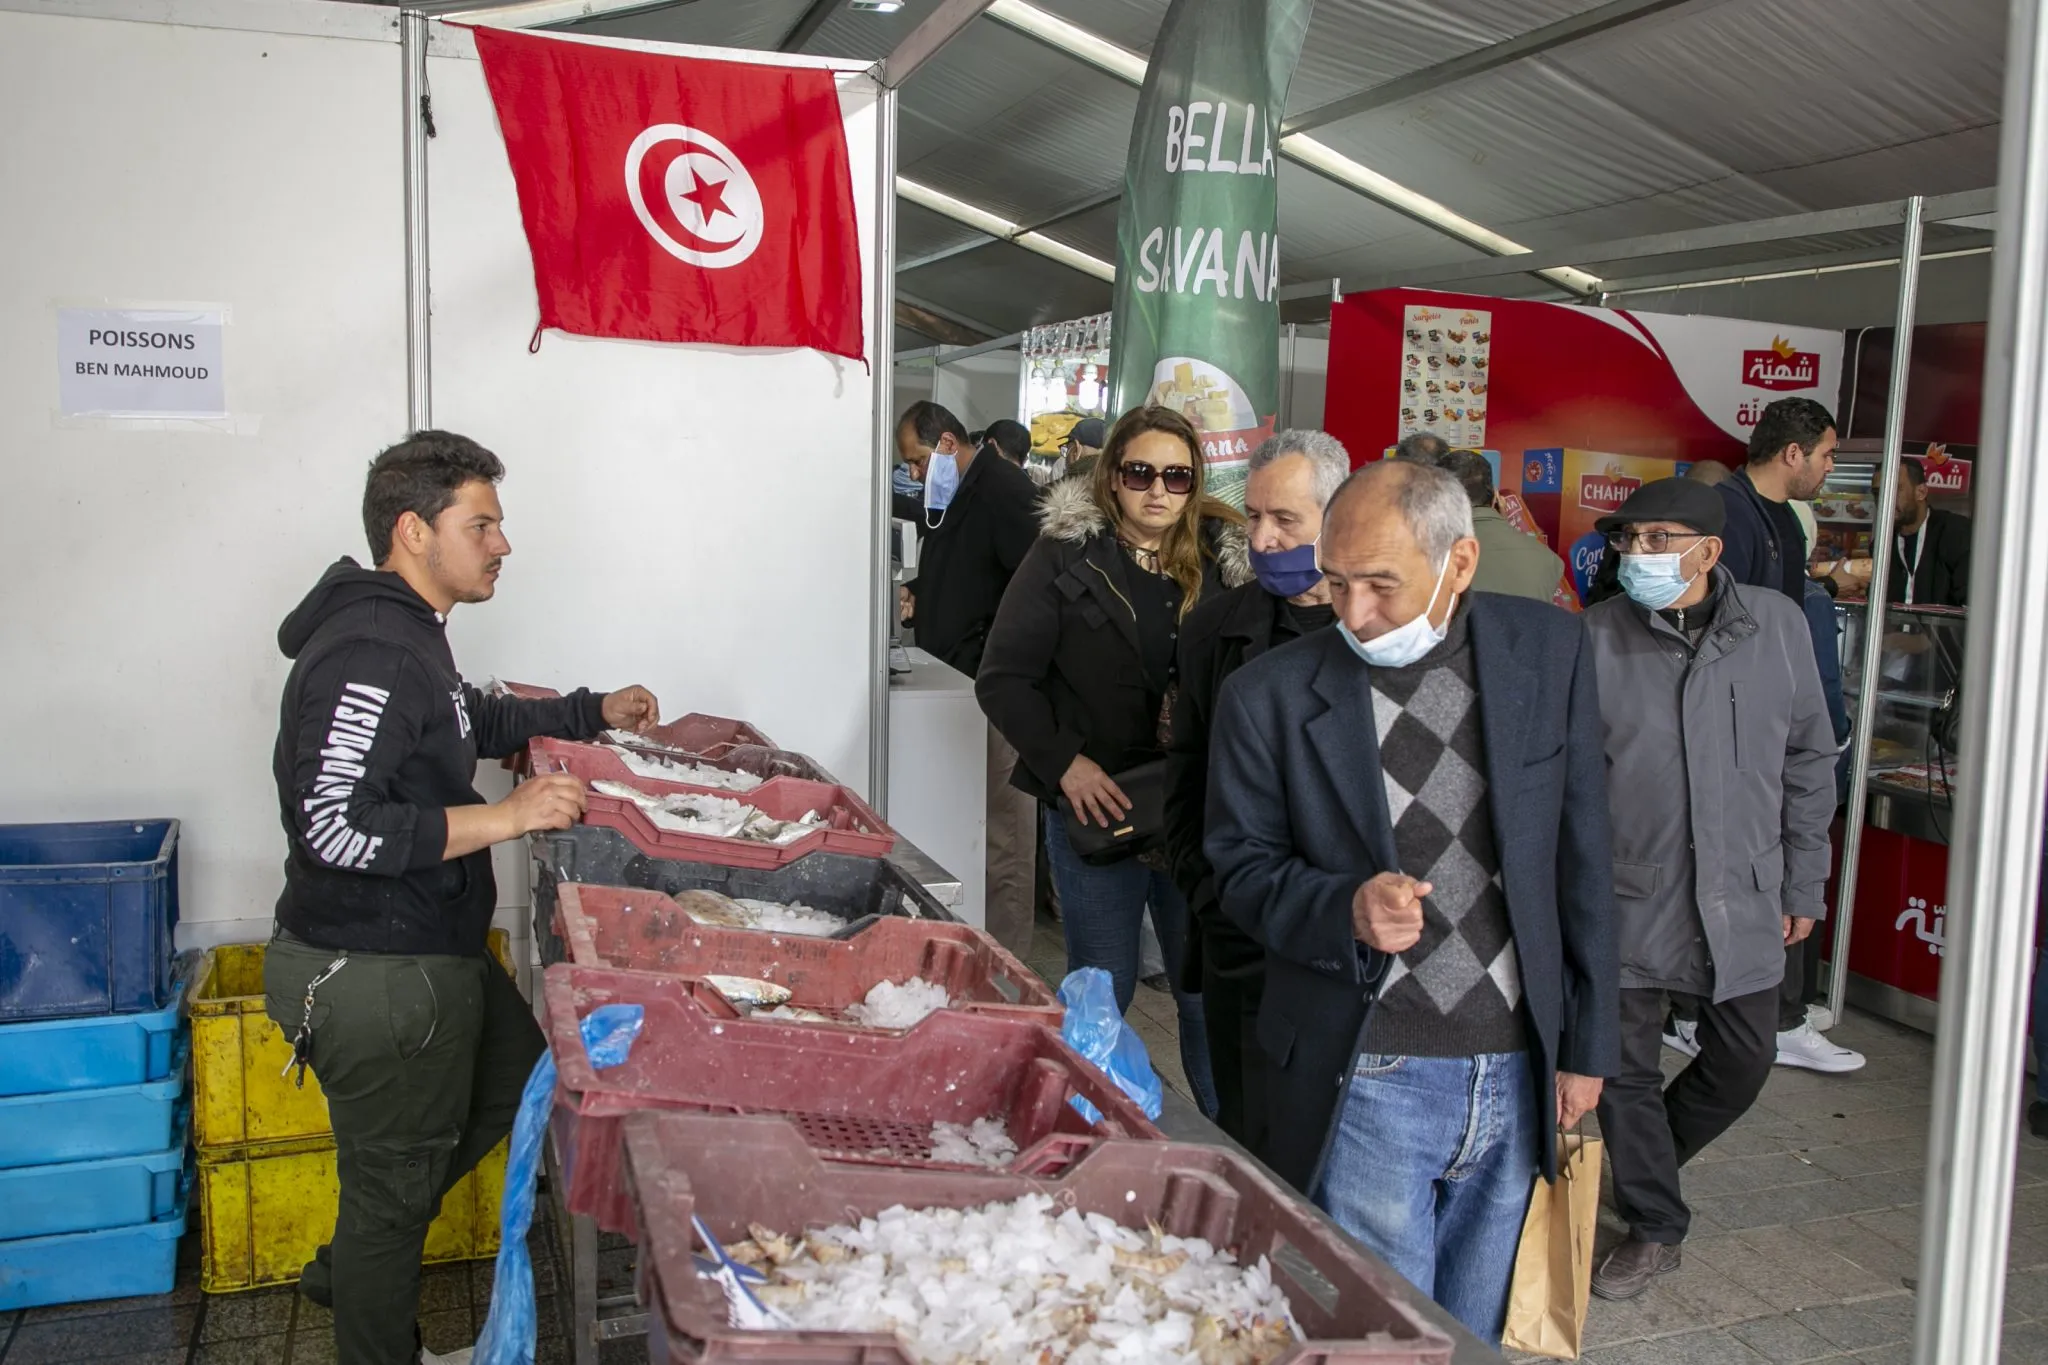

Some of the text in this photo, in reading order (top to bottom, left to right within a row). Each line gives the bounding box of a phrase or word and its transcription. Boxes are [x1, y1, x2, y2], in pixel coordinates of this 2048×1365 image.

[1165, 102, 1275, 178] BELLA
[89, 329, 195, 350] POISSONS
[75, 361, 208, 380] BEN MAHMOUD
